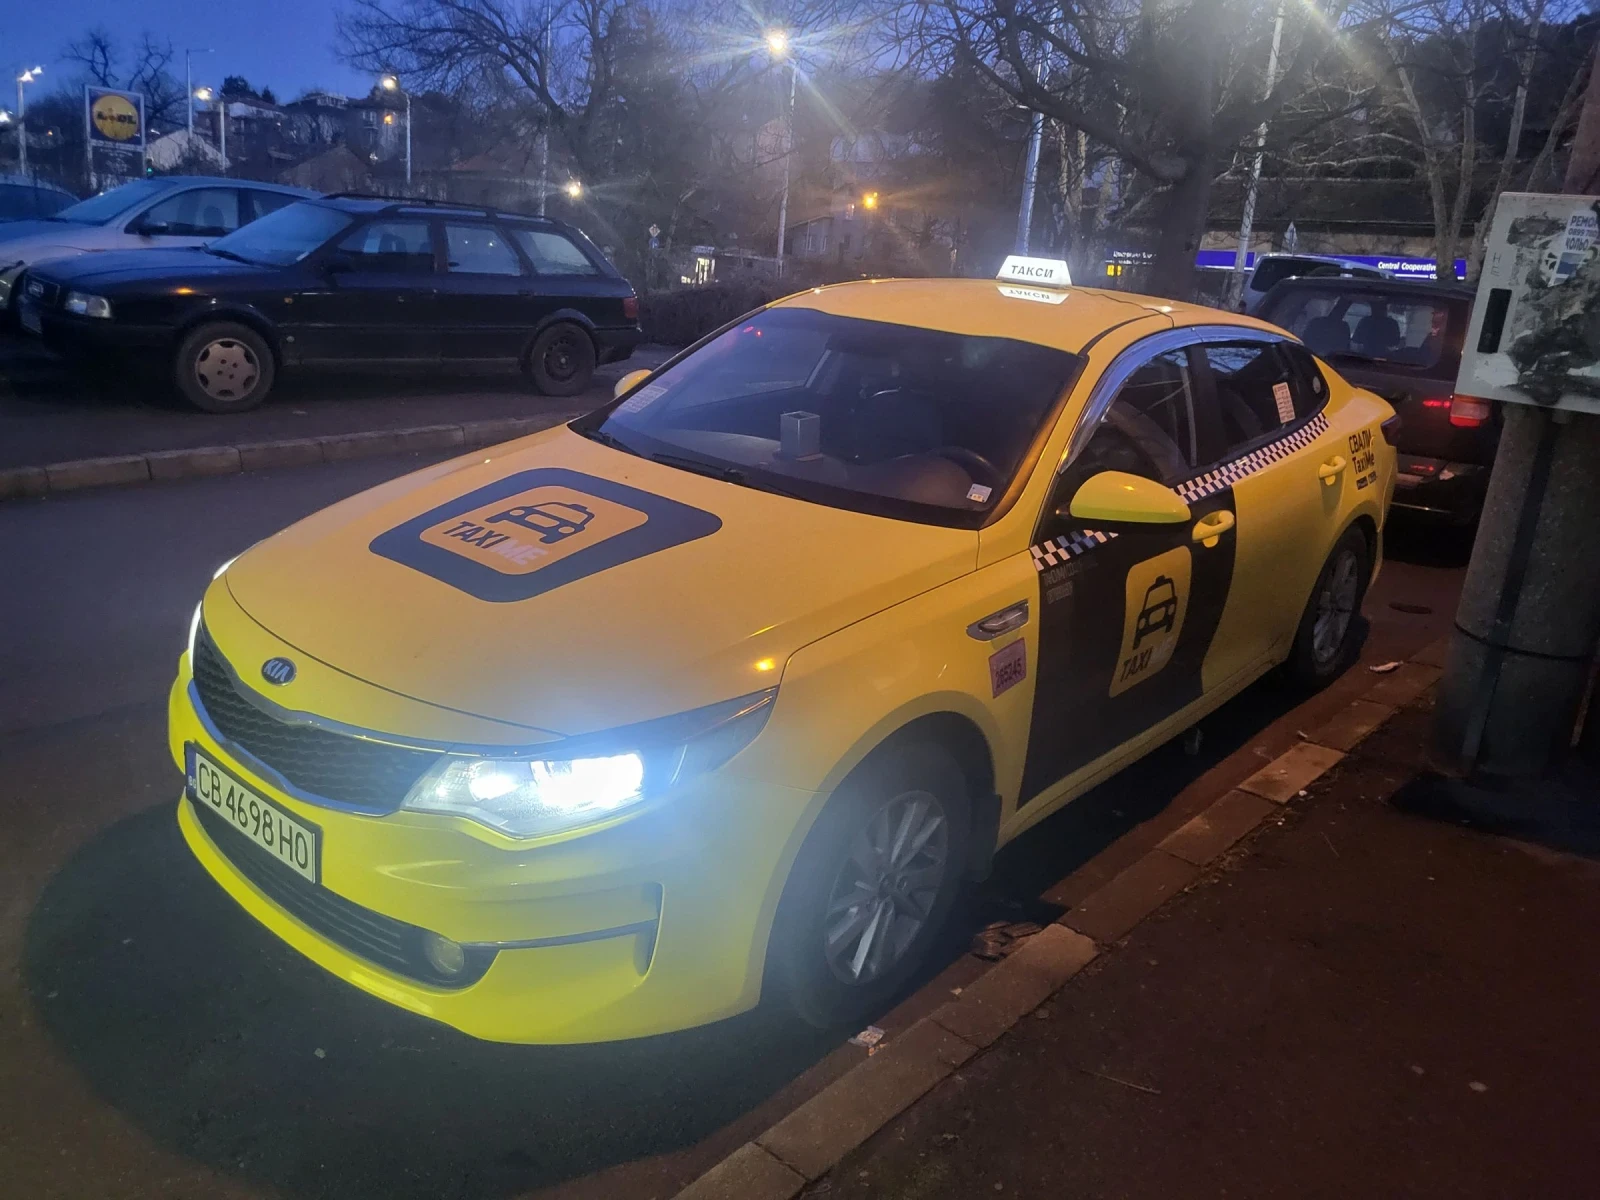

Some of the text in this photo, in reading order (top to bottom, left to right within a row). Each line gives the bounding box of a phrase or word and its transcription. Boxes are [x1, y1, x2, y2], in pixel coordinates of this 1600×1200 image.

[1011, 265, 1054, 278] ТАКСИ
[1378, 261, 1400, 270] Central
[1349, 429, 1372, 454] СВАЛИ
[1352, 450, 1375, 474] TaxiMe
[263, 660, 290, 682] KIA
[226, 785, 274, 847] 4698
